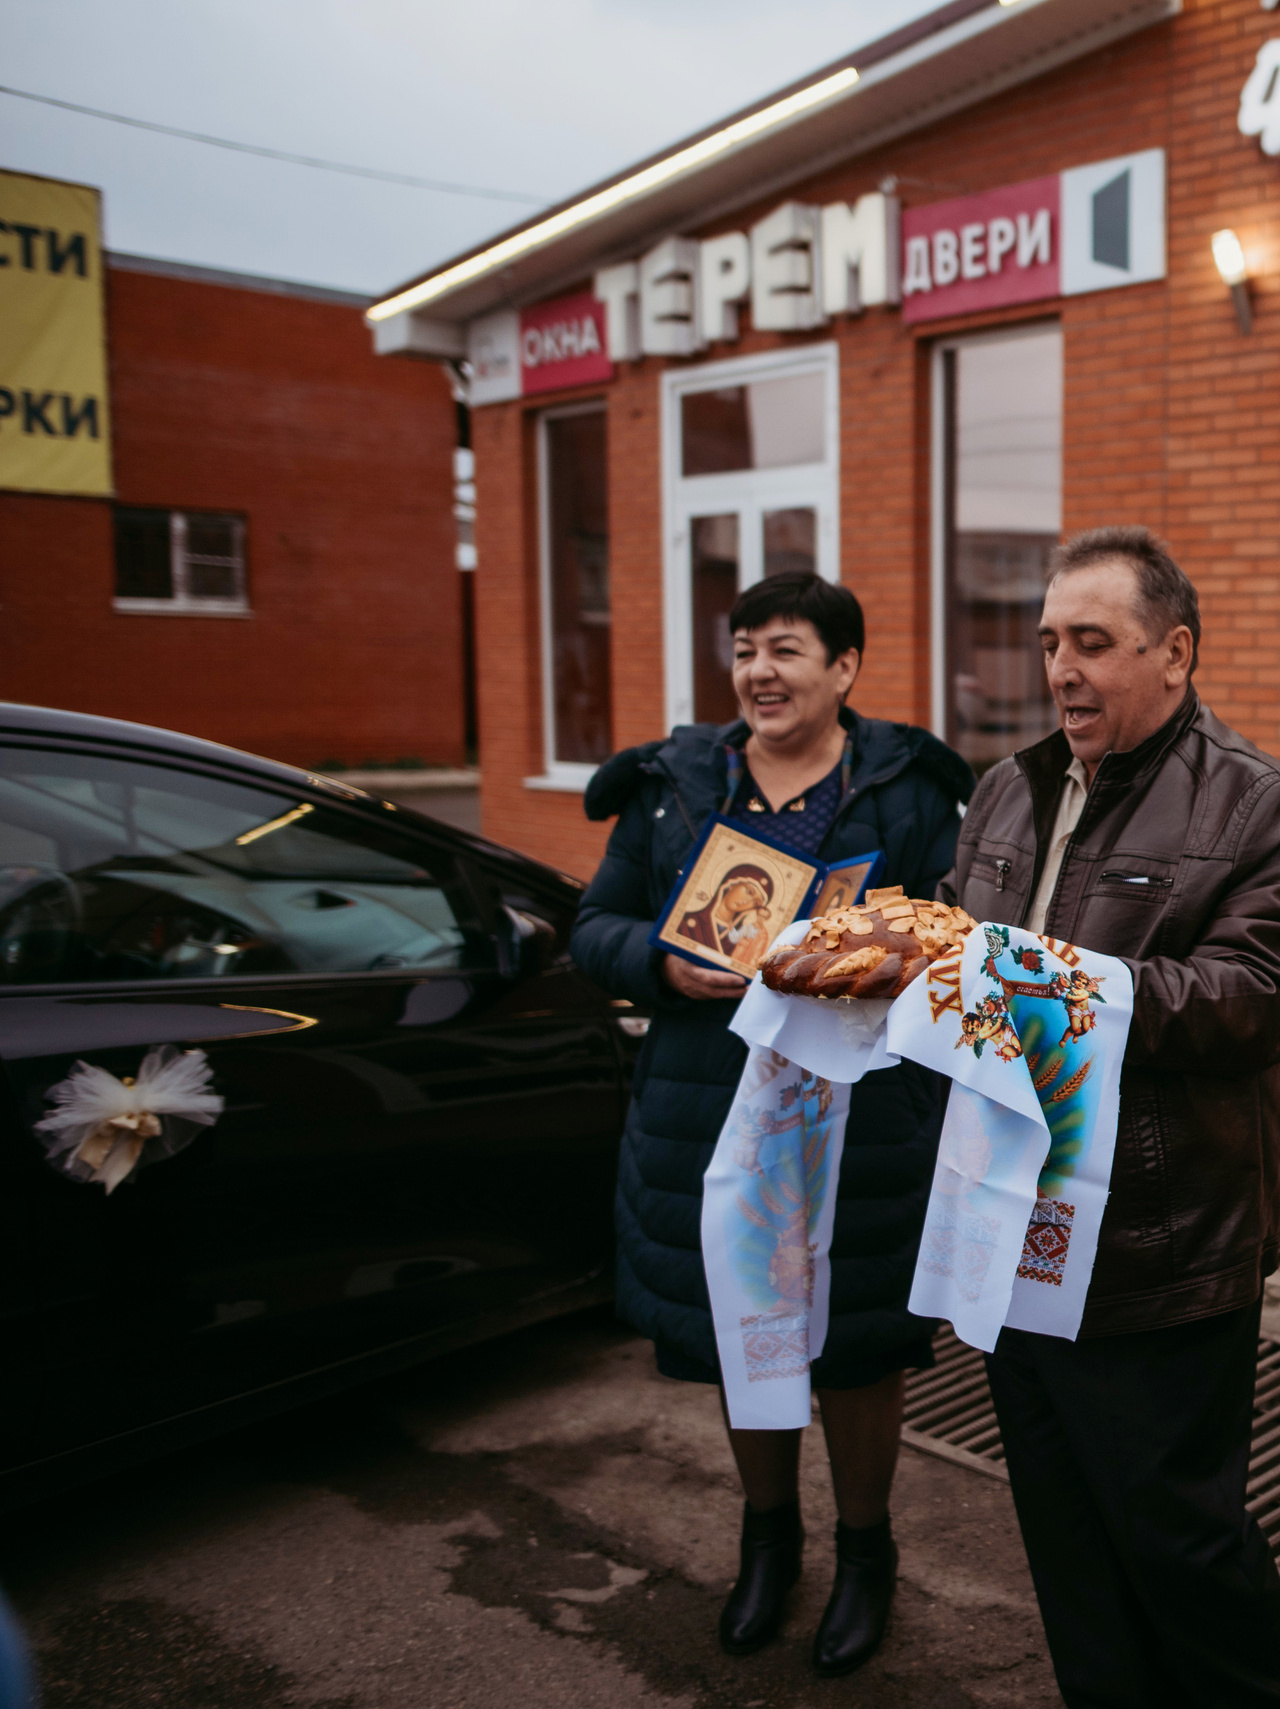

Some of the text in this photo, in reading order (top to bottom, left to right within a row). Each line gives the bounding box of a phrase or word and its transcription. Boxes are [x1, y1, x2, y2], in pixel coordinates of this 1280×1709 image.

[595, 191, 899, 361] ТЕРЕМ
[903, 208, 1052, 297] ДВЕРИ
[522, 314, 601, 368] ОКНА
